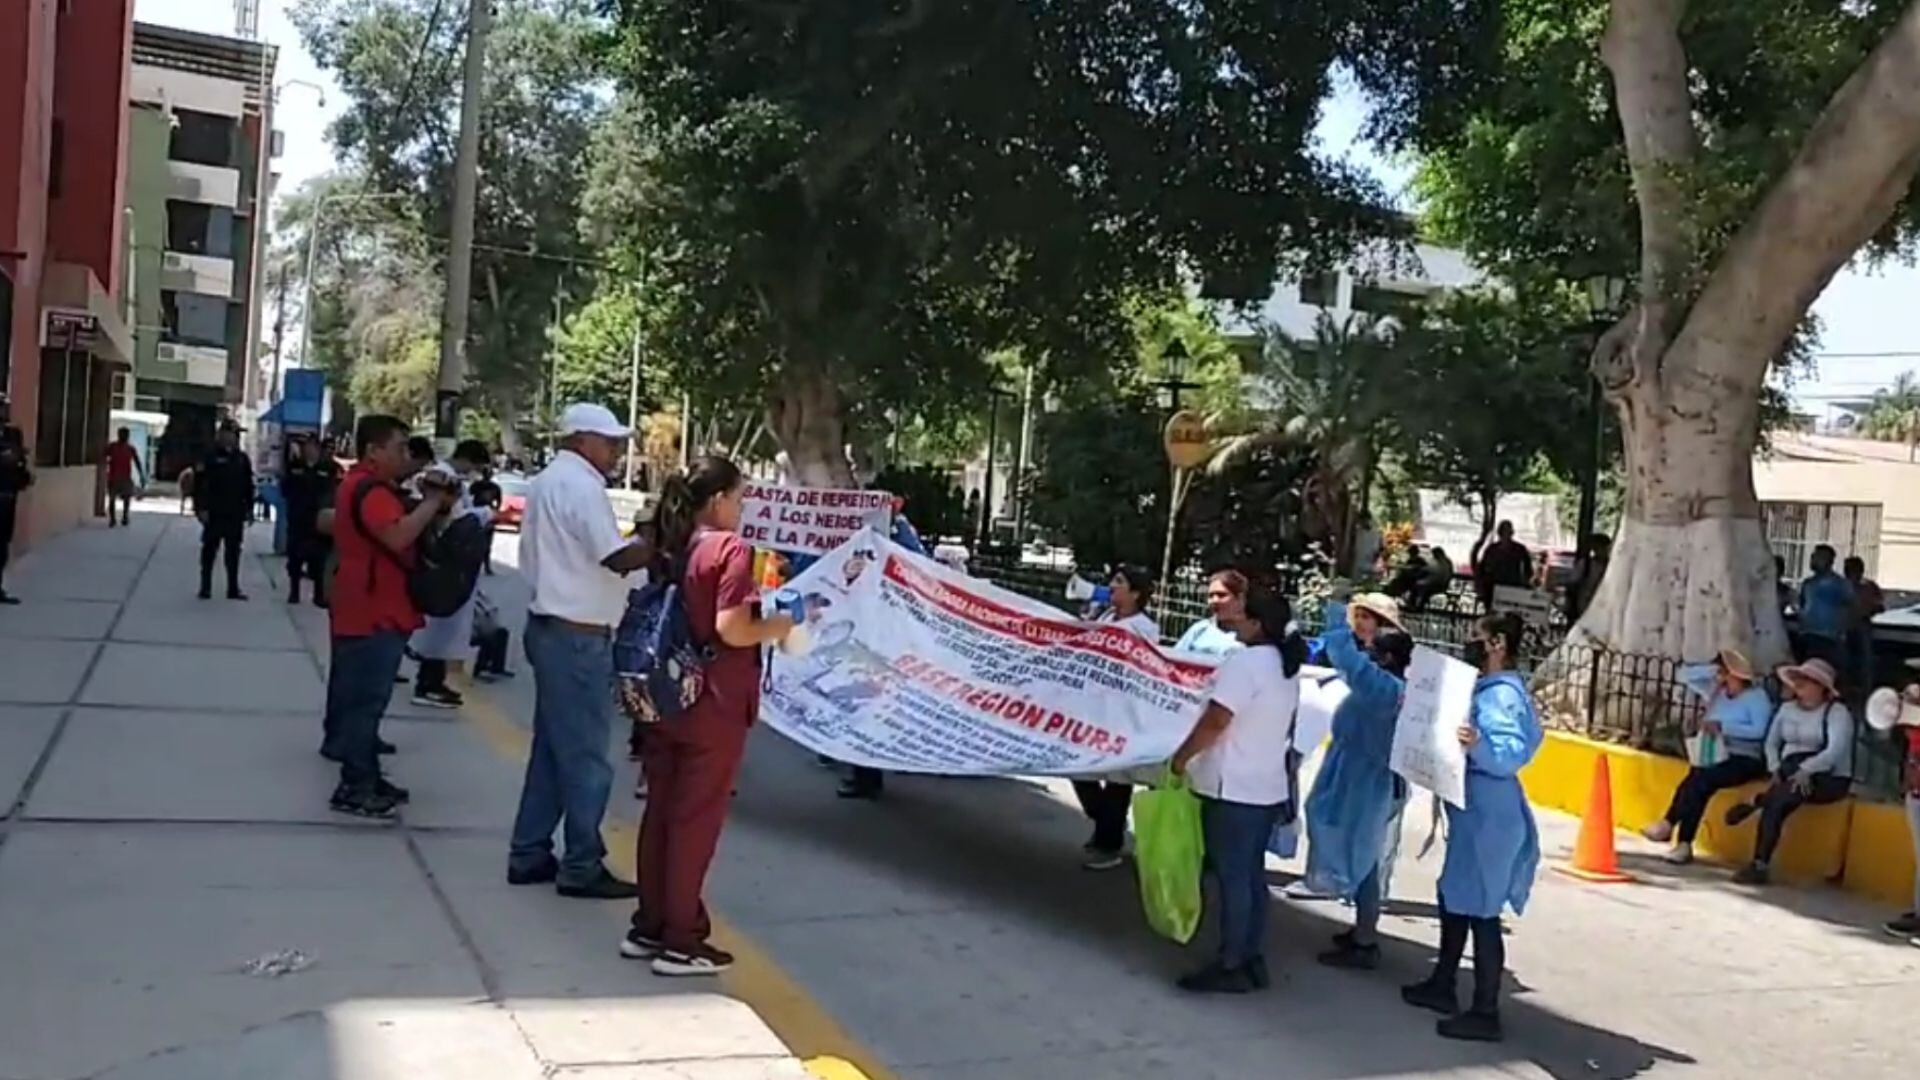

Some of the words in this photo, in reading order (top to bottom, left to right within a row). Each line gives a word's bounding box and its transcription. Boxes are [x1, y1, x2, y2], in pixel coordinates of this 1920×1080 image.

[743, 485, 793, 504] BASTA
[796, 491, 819, 507] DE
[757, 505, 771, 520] A
[779, 507, 811, 525] LOS
[741, 524, 769, 541] DE
[775, 528, 798, 546] LA
[892, 653, 960, 691] BASE
[1043, 711, 1127, 755] PIURA
